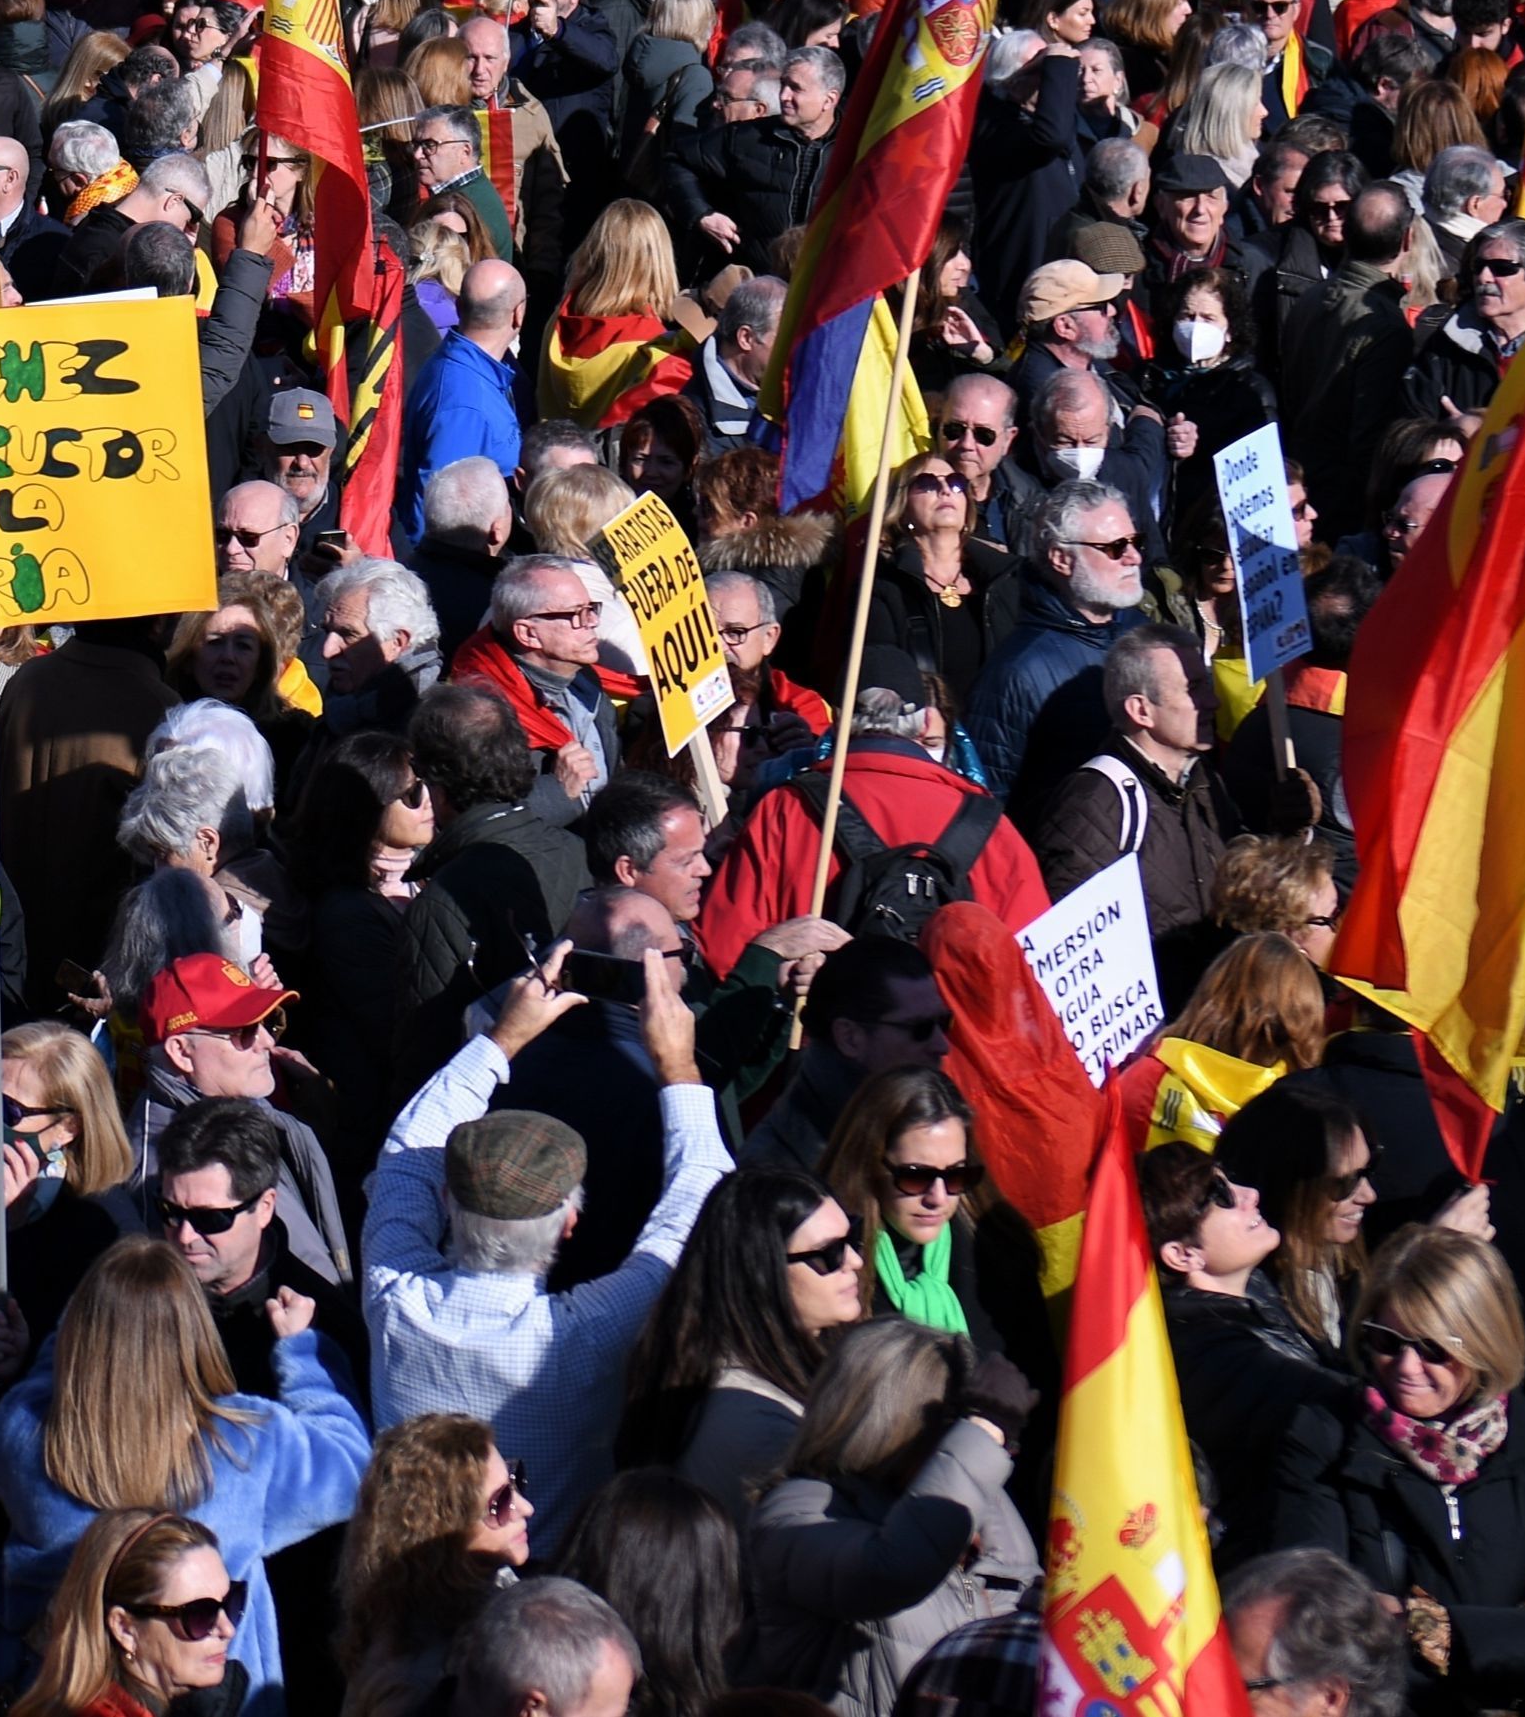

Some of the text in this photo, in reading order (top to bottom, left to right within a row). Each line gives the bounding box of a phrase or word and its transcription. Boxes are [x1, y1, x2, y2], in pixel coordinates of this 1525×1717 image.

[1228, 485, 1275, 528] podemos
[619, 547, 699, 628] FUERA DE
[650, 592, 719, 703] AQUÍ!
[1030, 899, 1122, 979] MERSIÓN
[1055, 948, 1105, 998] OTRA
[1090, 979, 1149, 1037] BUSCA
